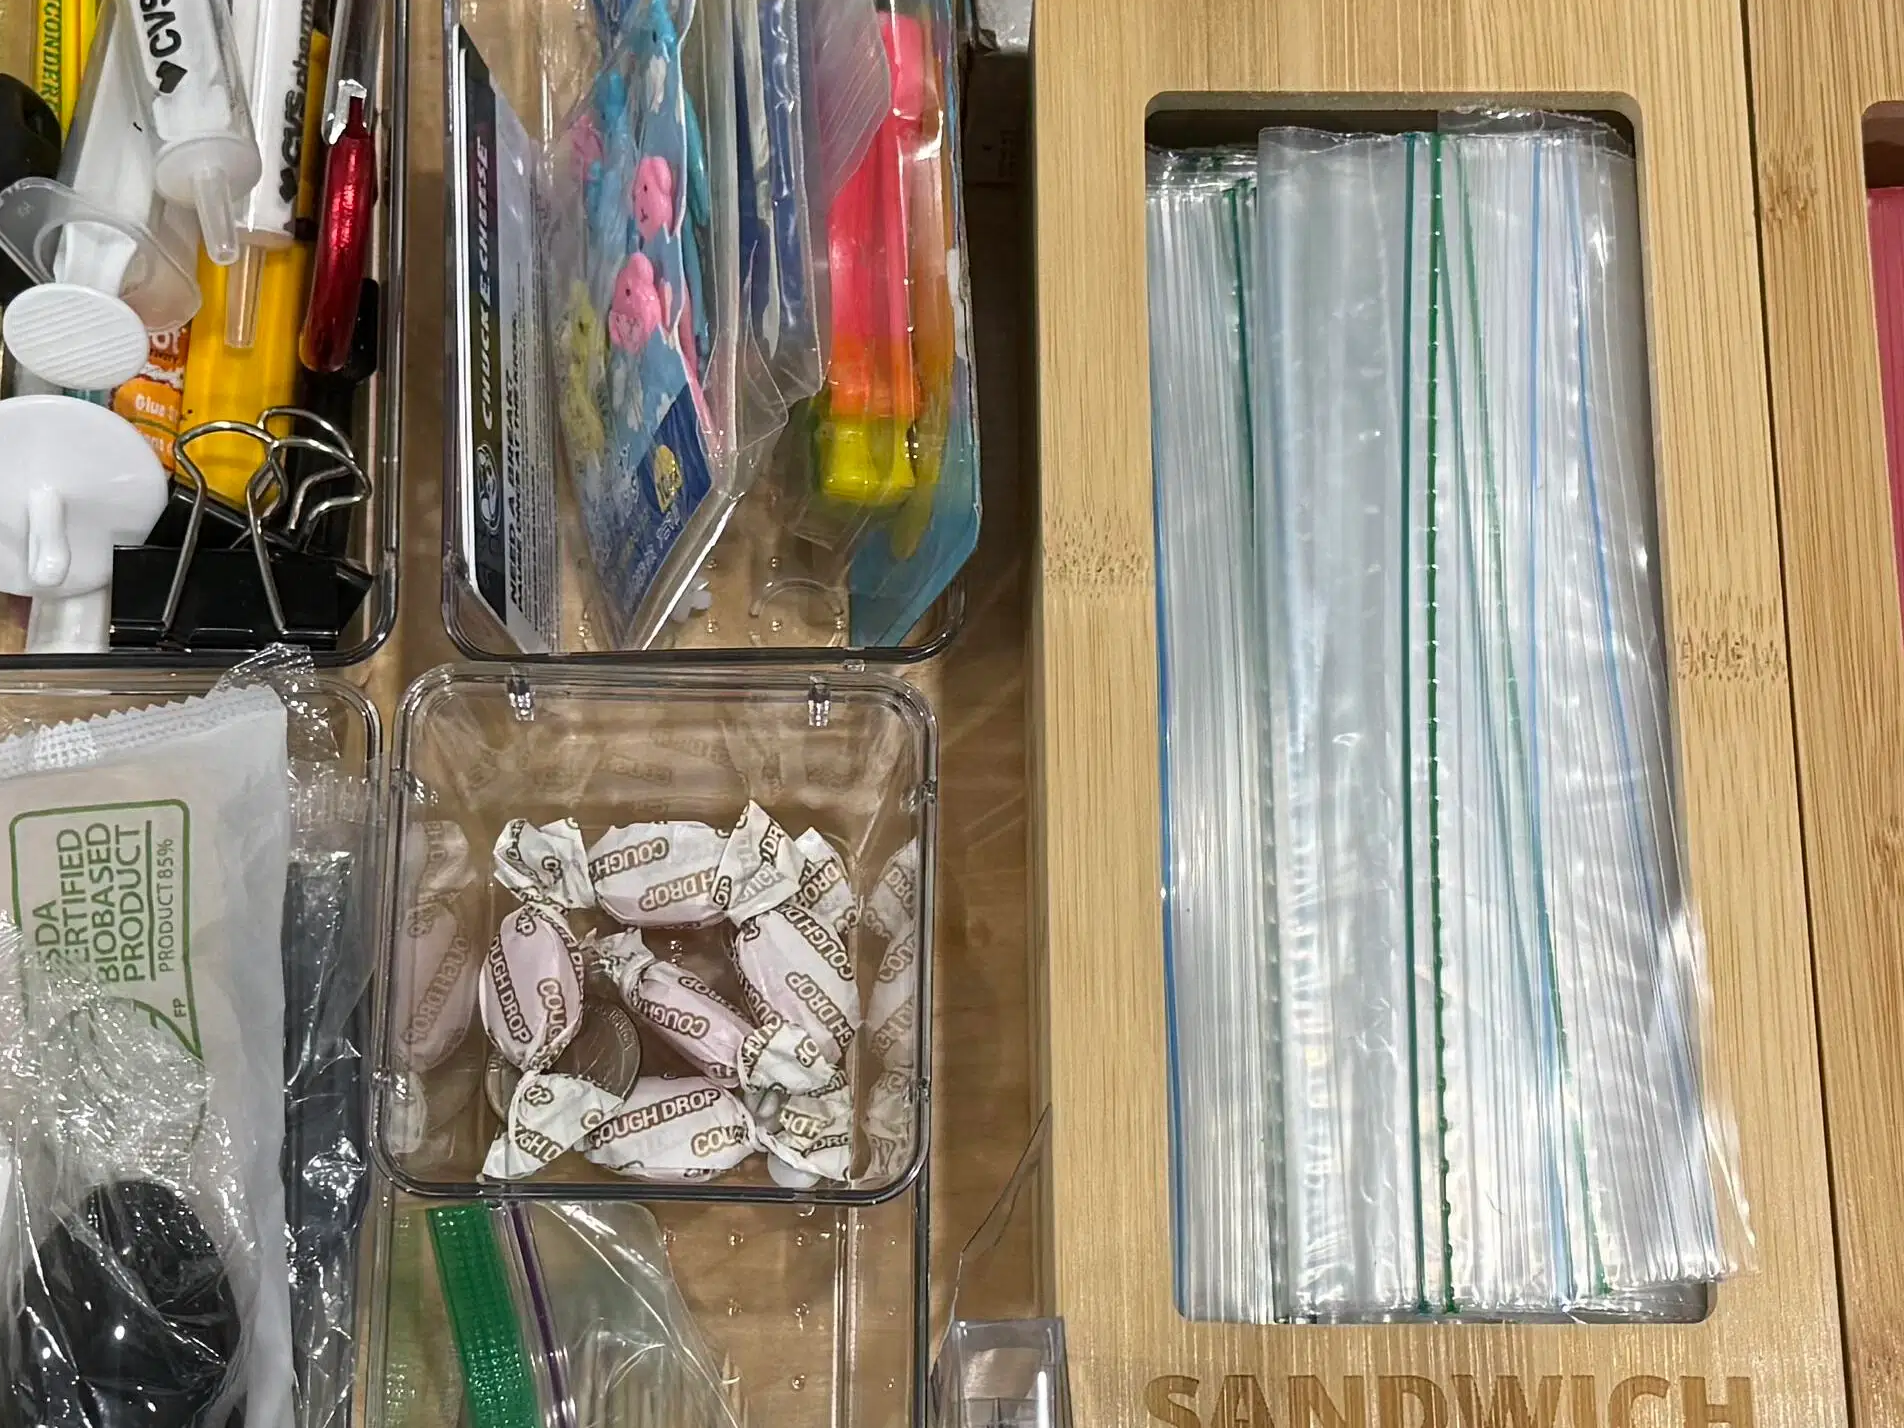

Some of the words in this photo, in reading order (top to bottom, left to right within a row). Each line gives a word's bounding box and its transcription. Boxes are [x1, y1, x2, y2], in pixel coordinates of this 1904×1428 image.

[475, 136, 491, 273] CHEESE
[480, 305, 495, 431] CHUCK
[85, 822, 121, 983] BIOBASED
[114, 824, 146, 983] PRODUCT
[156, 838, 176, 881] 85%
[156, 882, 176, 973] PRODUCT
[172, 997, 187, 1019] FP
[658, 1087, 723, 1125] DROP
